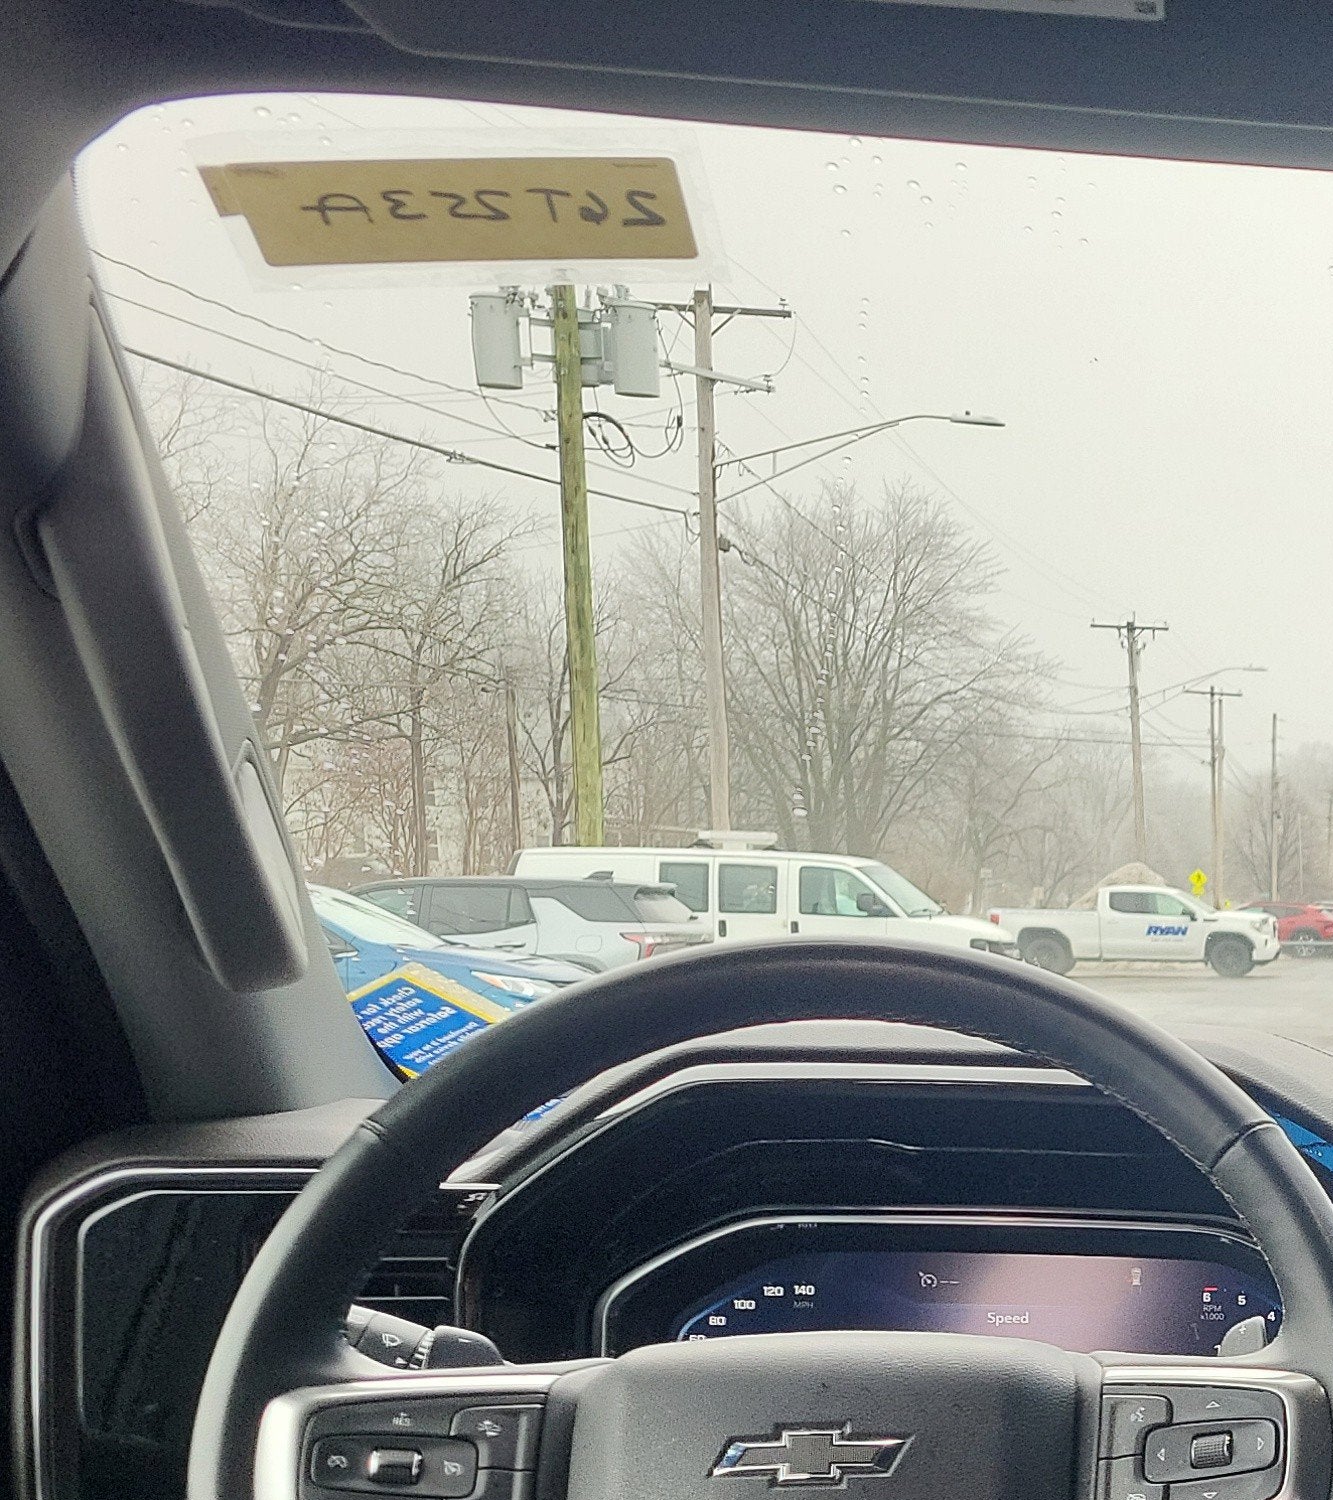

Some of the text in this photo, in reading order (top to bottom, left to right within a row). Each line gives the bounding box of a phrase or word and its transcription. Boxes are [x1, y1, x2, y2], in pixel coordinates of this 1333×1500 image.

[1146, 925, 1189, 936] RYAN
[763, 1286, 785, 1296] 120
[793, 1285, 815, 1295] 140
[734, 1300, 756, 1310] 100
[1237, 1295, 1246, 1306] 5
[709, 1316, 727, 1326] 80
[987, 1311, 1030, 1327] Speed
[1267, 1311, 1276, 1321] 4
